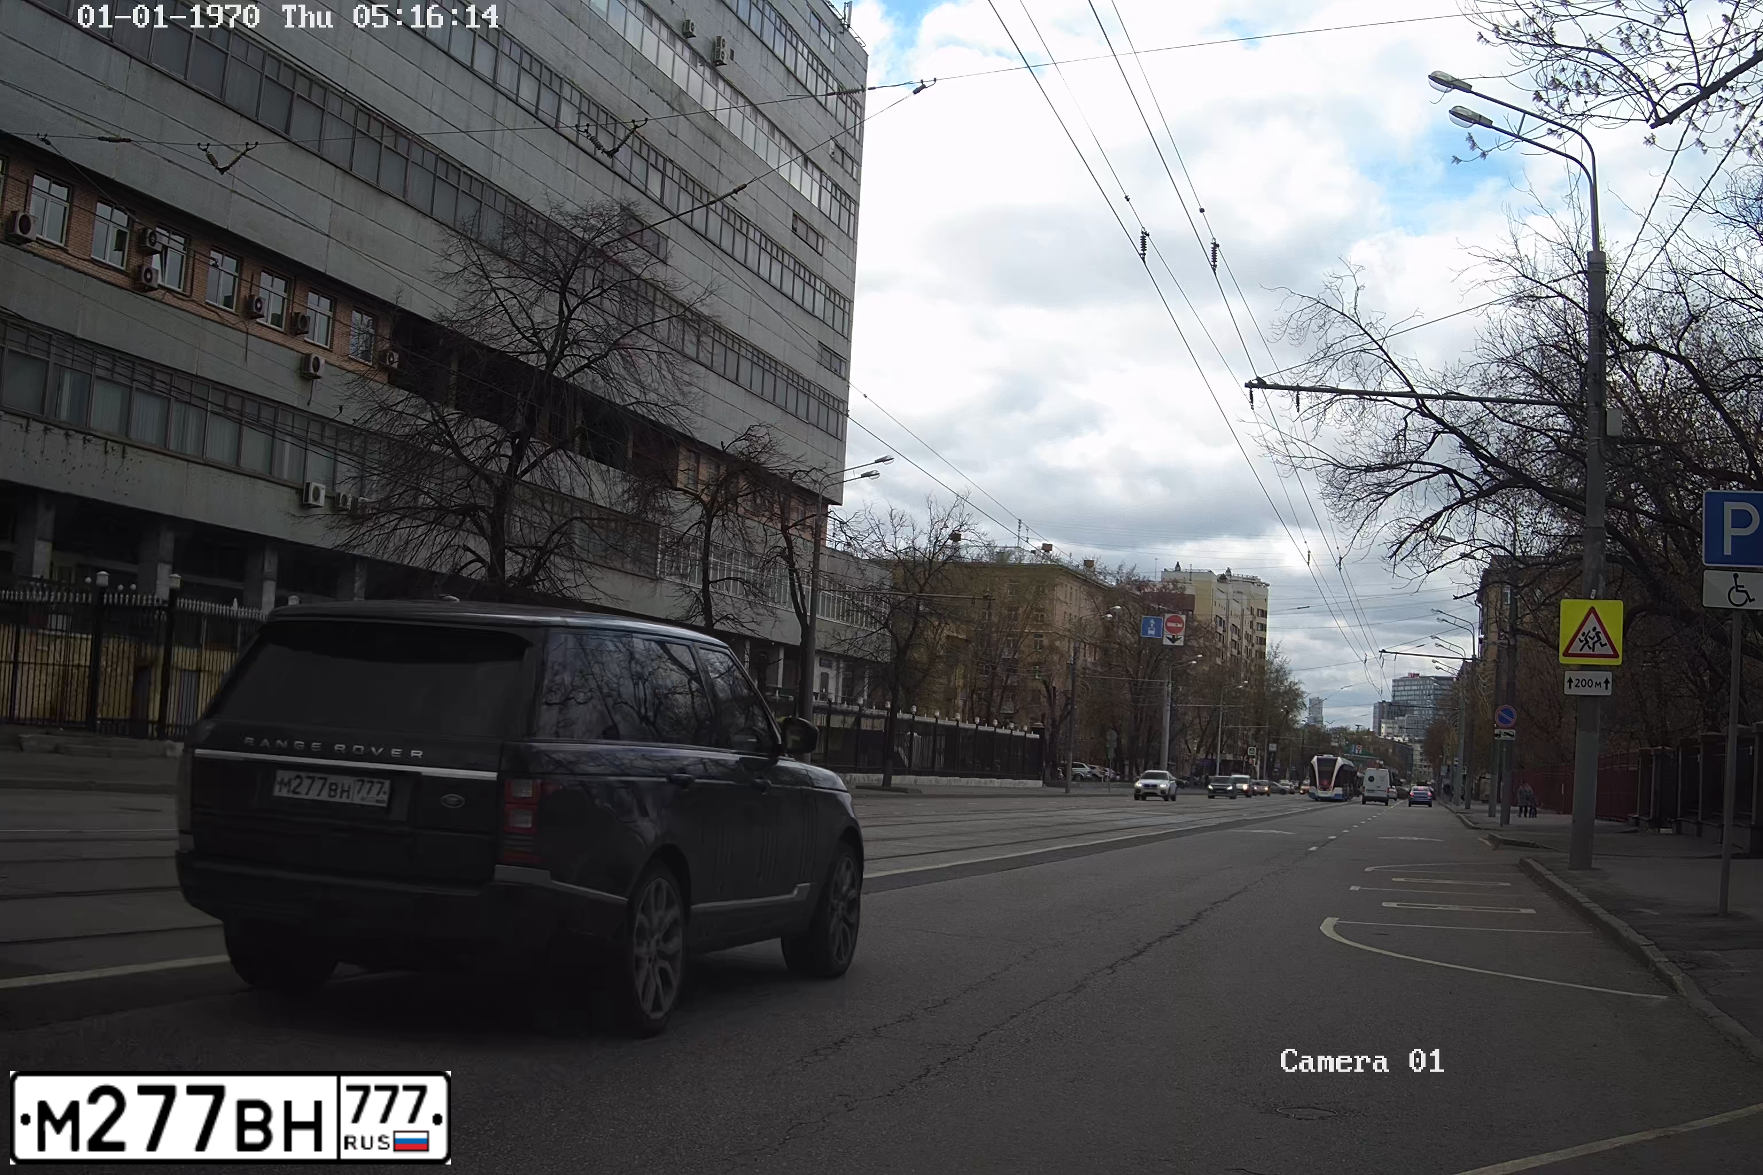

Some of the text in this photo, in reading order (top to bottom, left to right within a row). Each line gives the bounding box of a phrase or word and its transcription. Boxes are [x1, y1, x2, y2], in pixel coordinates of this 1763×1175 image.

[1723, 501, 1760, 556] P
[244, 736, 423, 759] RANGE ROVER
[355, 779, 385, 796] 777
